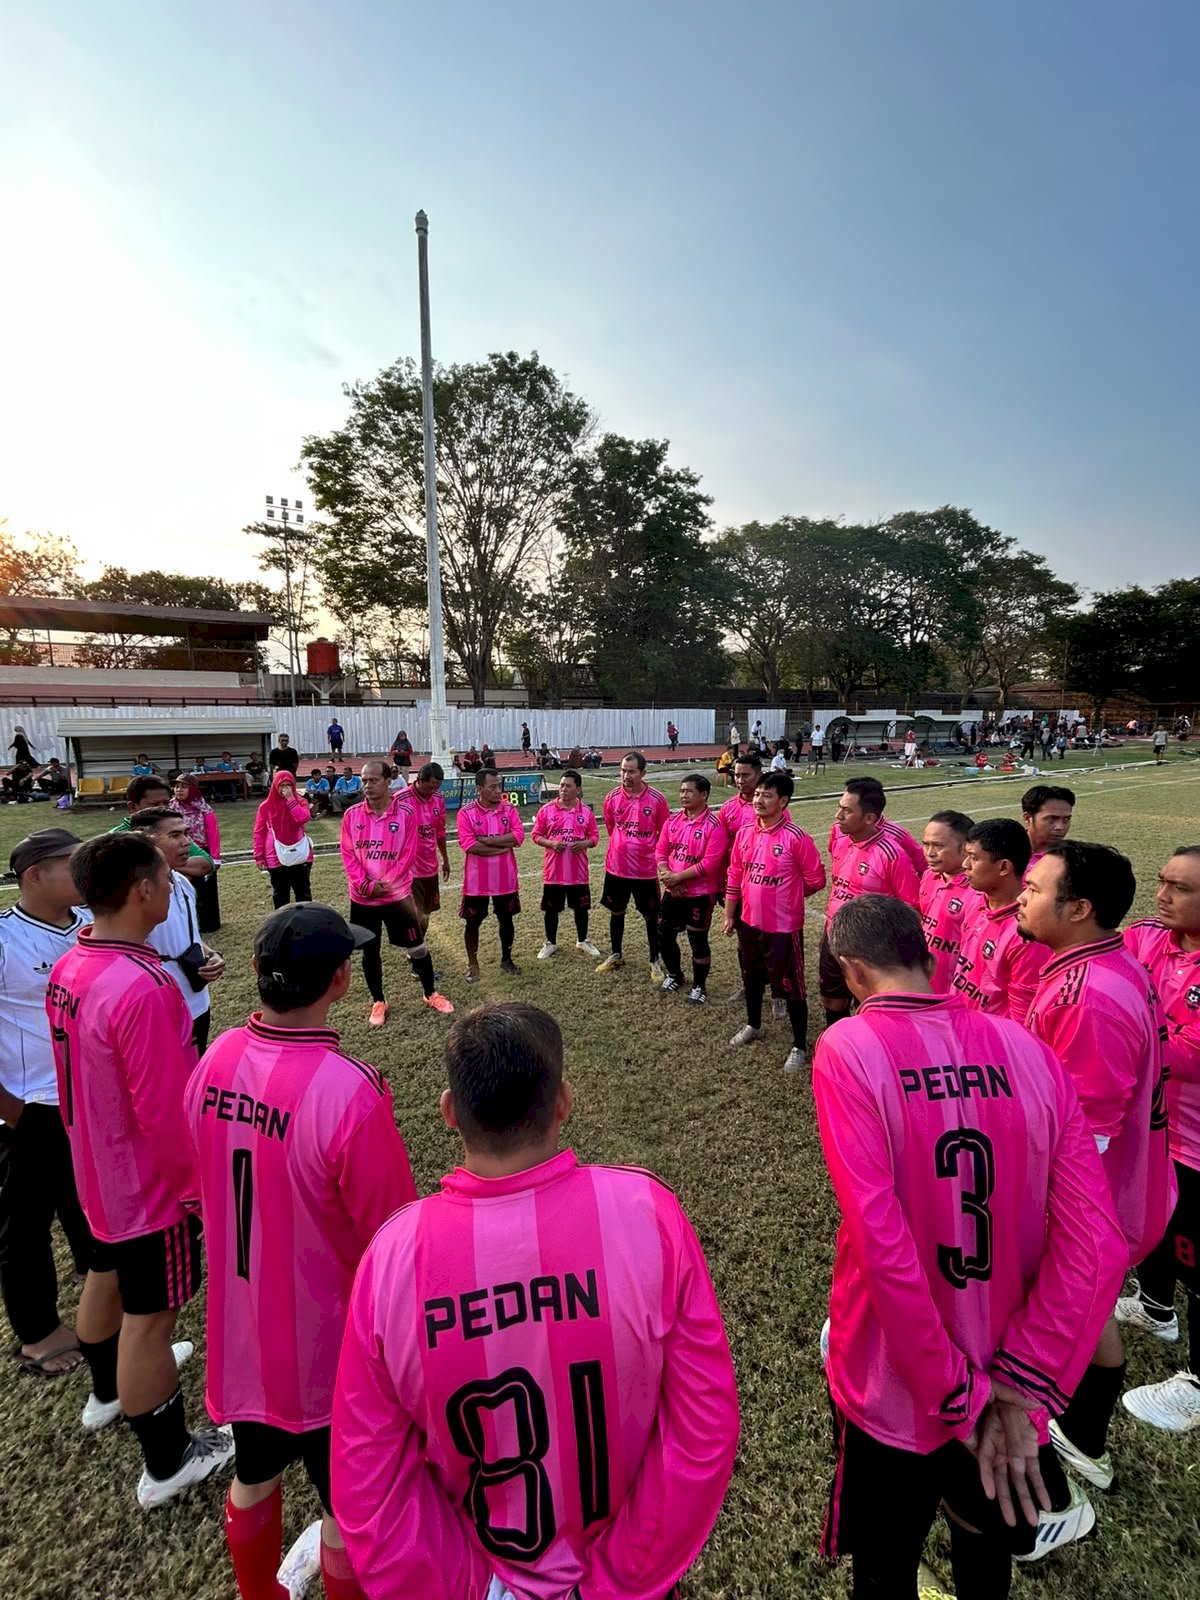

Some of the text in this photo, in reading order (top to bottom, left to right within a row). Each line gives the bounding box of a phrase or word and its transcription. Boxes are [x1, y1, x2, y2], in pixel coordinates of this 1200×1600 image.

[202, 1085, 291, 1142] PEDAN
[899, 1064, 1014, 1103] PEDAN
[934, 1127, 995, 1290] 3
[1174, 1234, 1195, 1267] 8
[424, 1269, 600, 1349] PEDAN
[445, 1360, 610, 1563] 81
